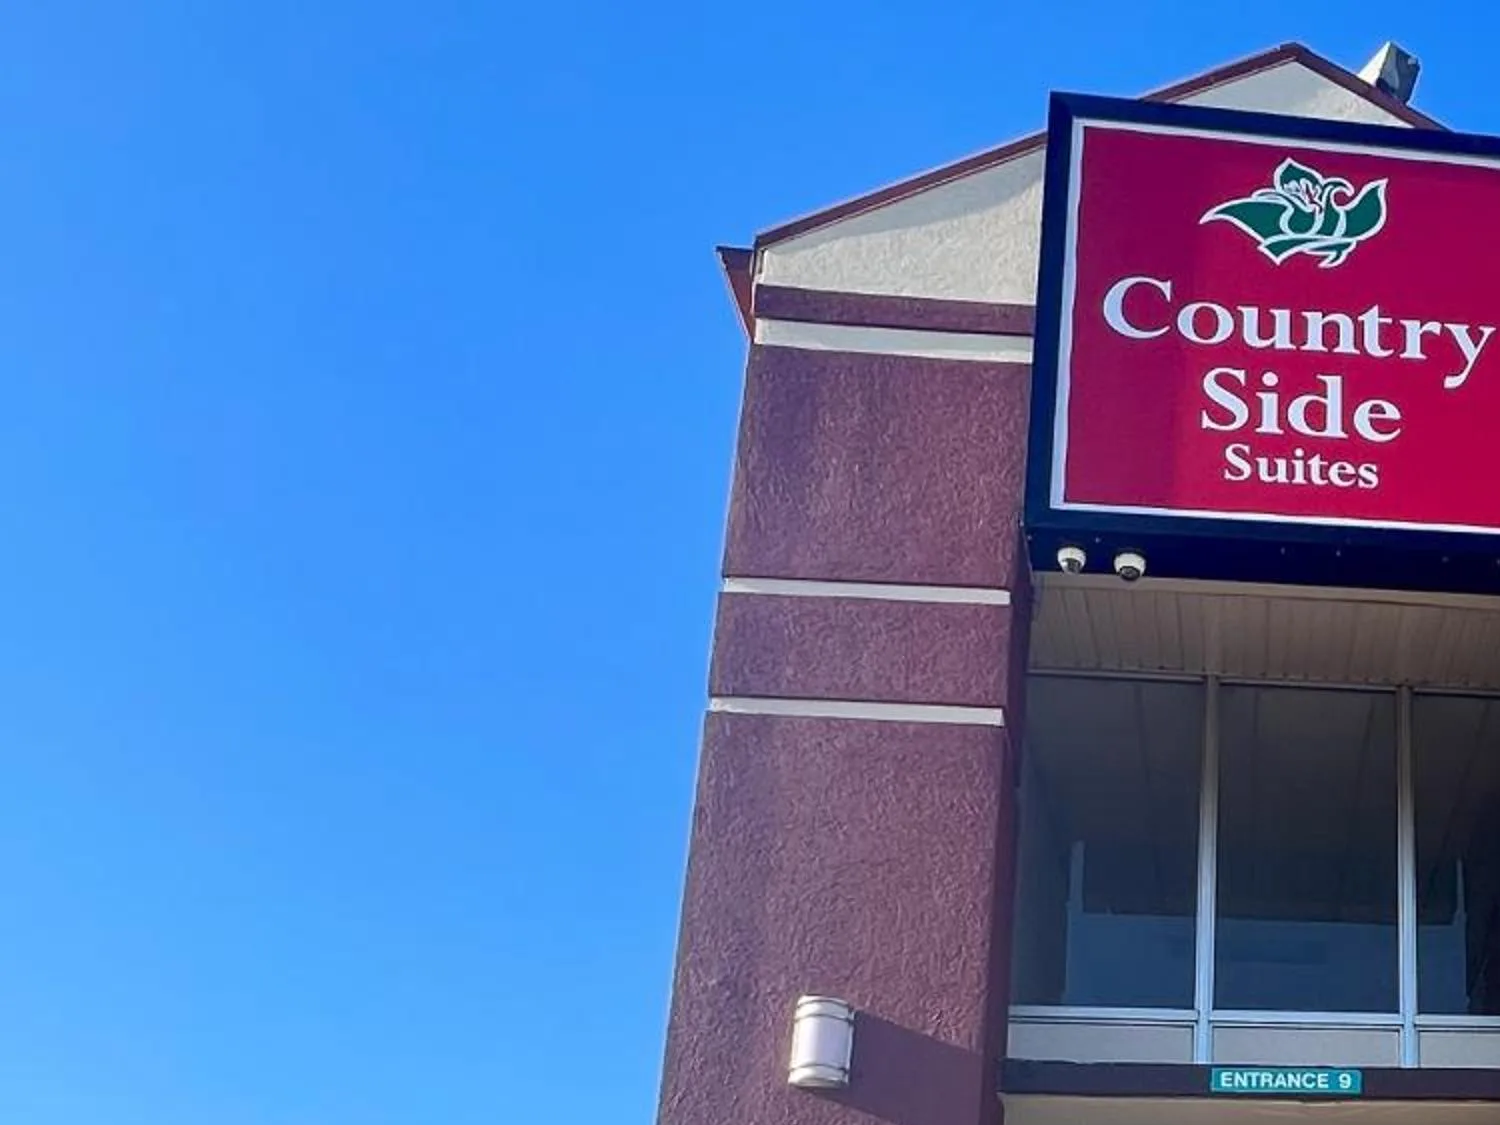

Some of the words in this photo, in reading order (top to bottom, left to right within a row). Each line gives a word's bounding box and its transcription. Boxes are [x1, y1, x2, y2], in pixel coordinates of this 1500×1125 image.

[1103, 276, 1496, 389] Country
[1201, 367, 1401, 442] Side
[1224, 443, 1379, 490] Suites
[1221, 1072, 1329, 1088] ENTRANCE
[1339, 1073, 1352, 1089] 9
